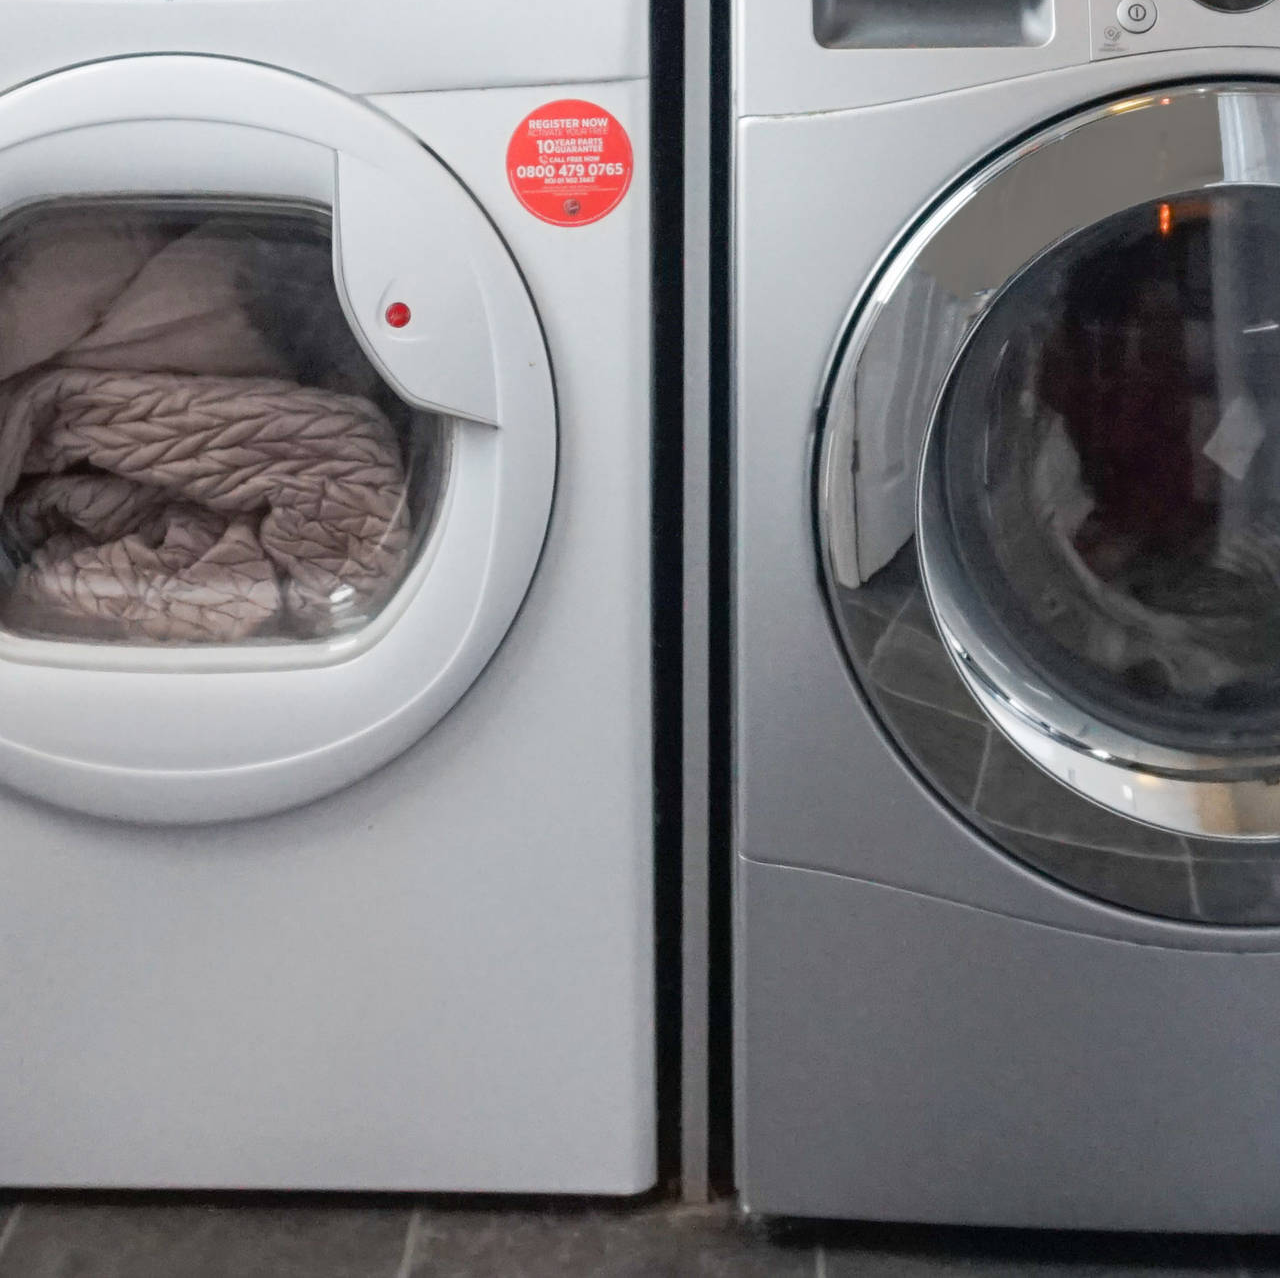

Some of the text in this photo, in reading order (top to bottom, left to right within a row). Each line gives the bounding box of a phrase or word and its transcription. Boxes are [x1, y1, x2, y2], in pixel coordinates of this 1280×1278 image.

[528, 118, 608, 130] REGISTER NOW
[536, 140, 555, 154] 10
[578, 137, 603, 146] PARTS
[555, 145, 603, 153] GUARANTEE
[517, 162, 623, 179] 0800 479 0765
